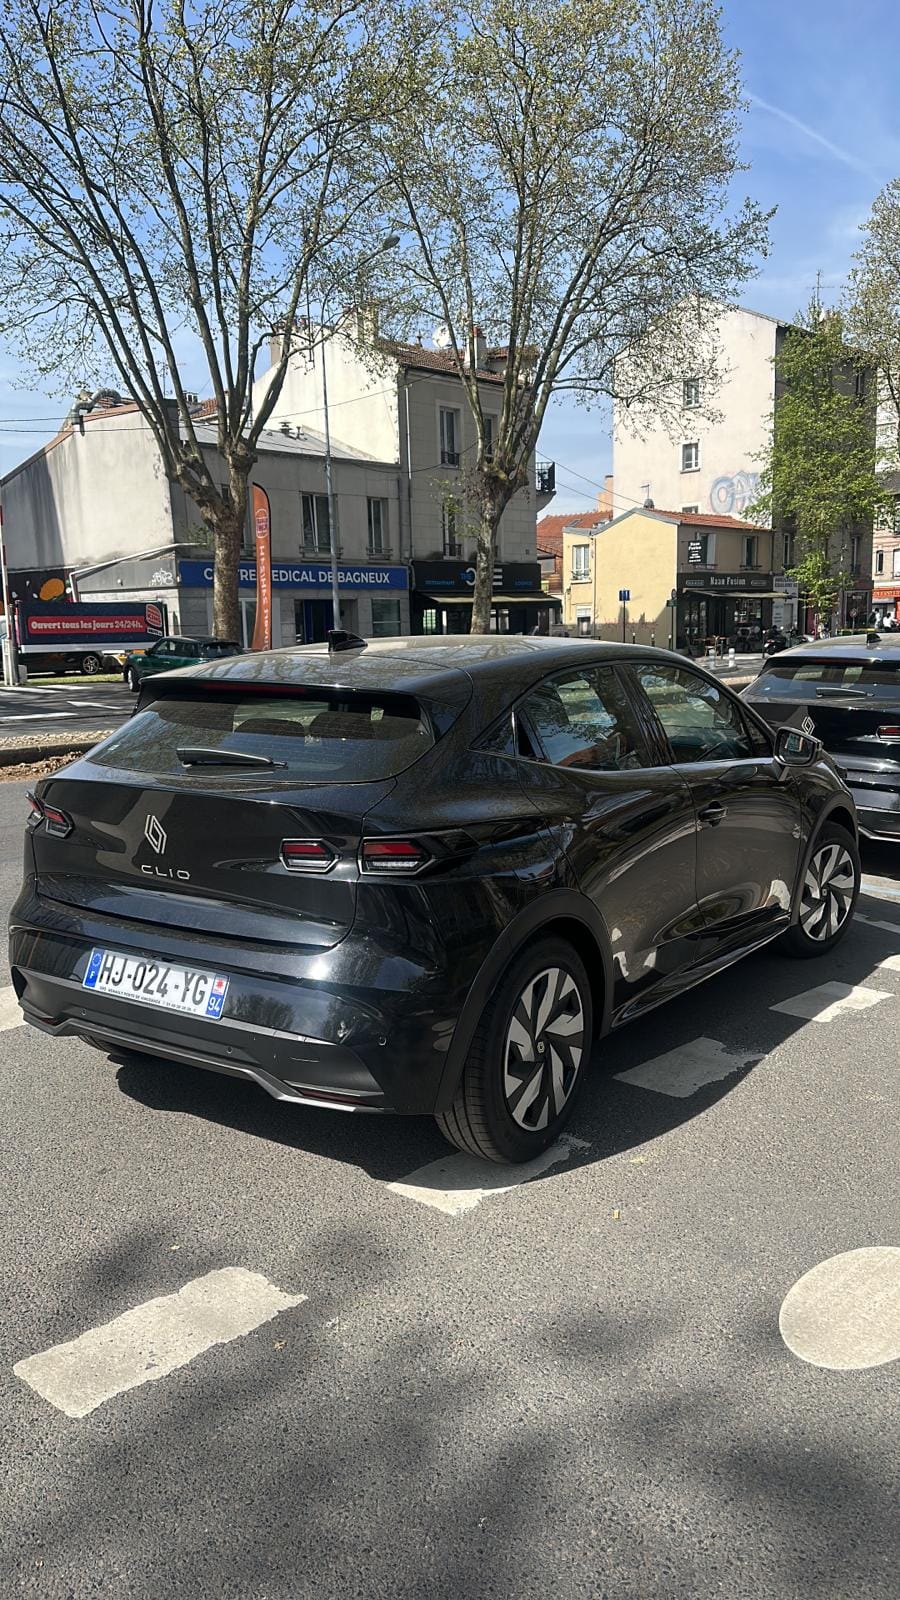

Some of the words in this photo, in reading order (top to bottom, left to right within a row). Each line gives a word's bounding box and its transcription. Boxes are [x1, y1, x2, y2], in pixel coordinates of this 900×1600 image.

[203, 567, 257, 581] CRE
[271, 569, 316, 583] EDICAL
[337, 571, 390, 584] BAGNEUX
[465, 567, 503, 586] OE
[31, 621, 61, 629] Ouvert
[62, 621, 80, 629] tous
[81, 620, 92, 629] les
[93, 620, 114, 631] jours
[115, 620, 143, 629] 24/24h.
[141, 865, 190, 880] CLIO
[89, 971, 96, 979] F
[99, 954, 208, 1006] HJ-024-YG
[208, 996, 222, 1013] 94
